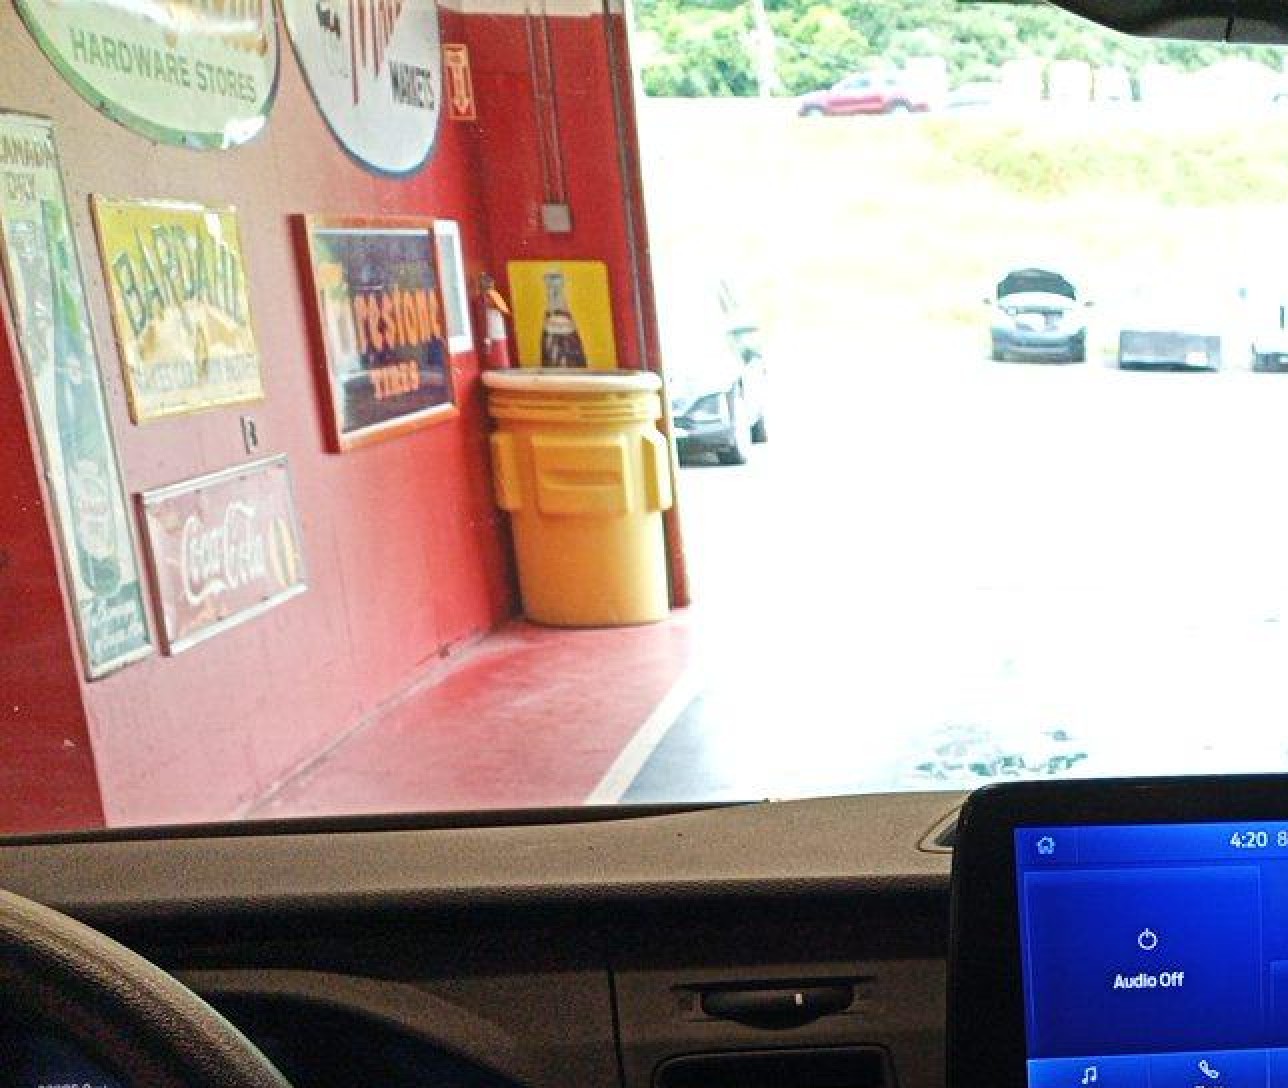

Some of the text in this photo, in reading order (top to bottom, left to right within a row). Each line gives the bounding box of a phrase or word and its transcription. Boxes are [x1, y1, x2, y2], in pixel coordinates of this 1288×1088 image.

[69, 28, 257, 103] HARDWARE STORES
[1230, 830, 1268, 848] 4:20
[1113, 971, 1185, 989] Audio Off
